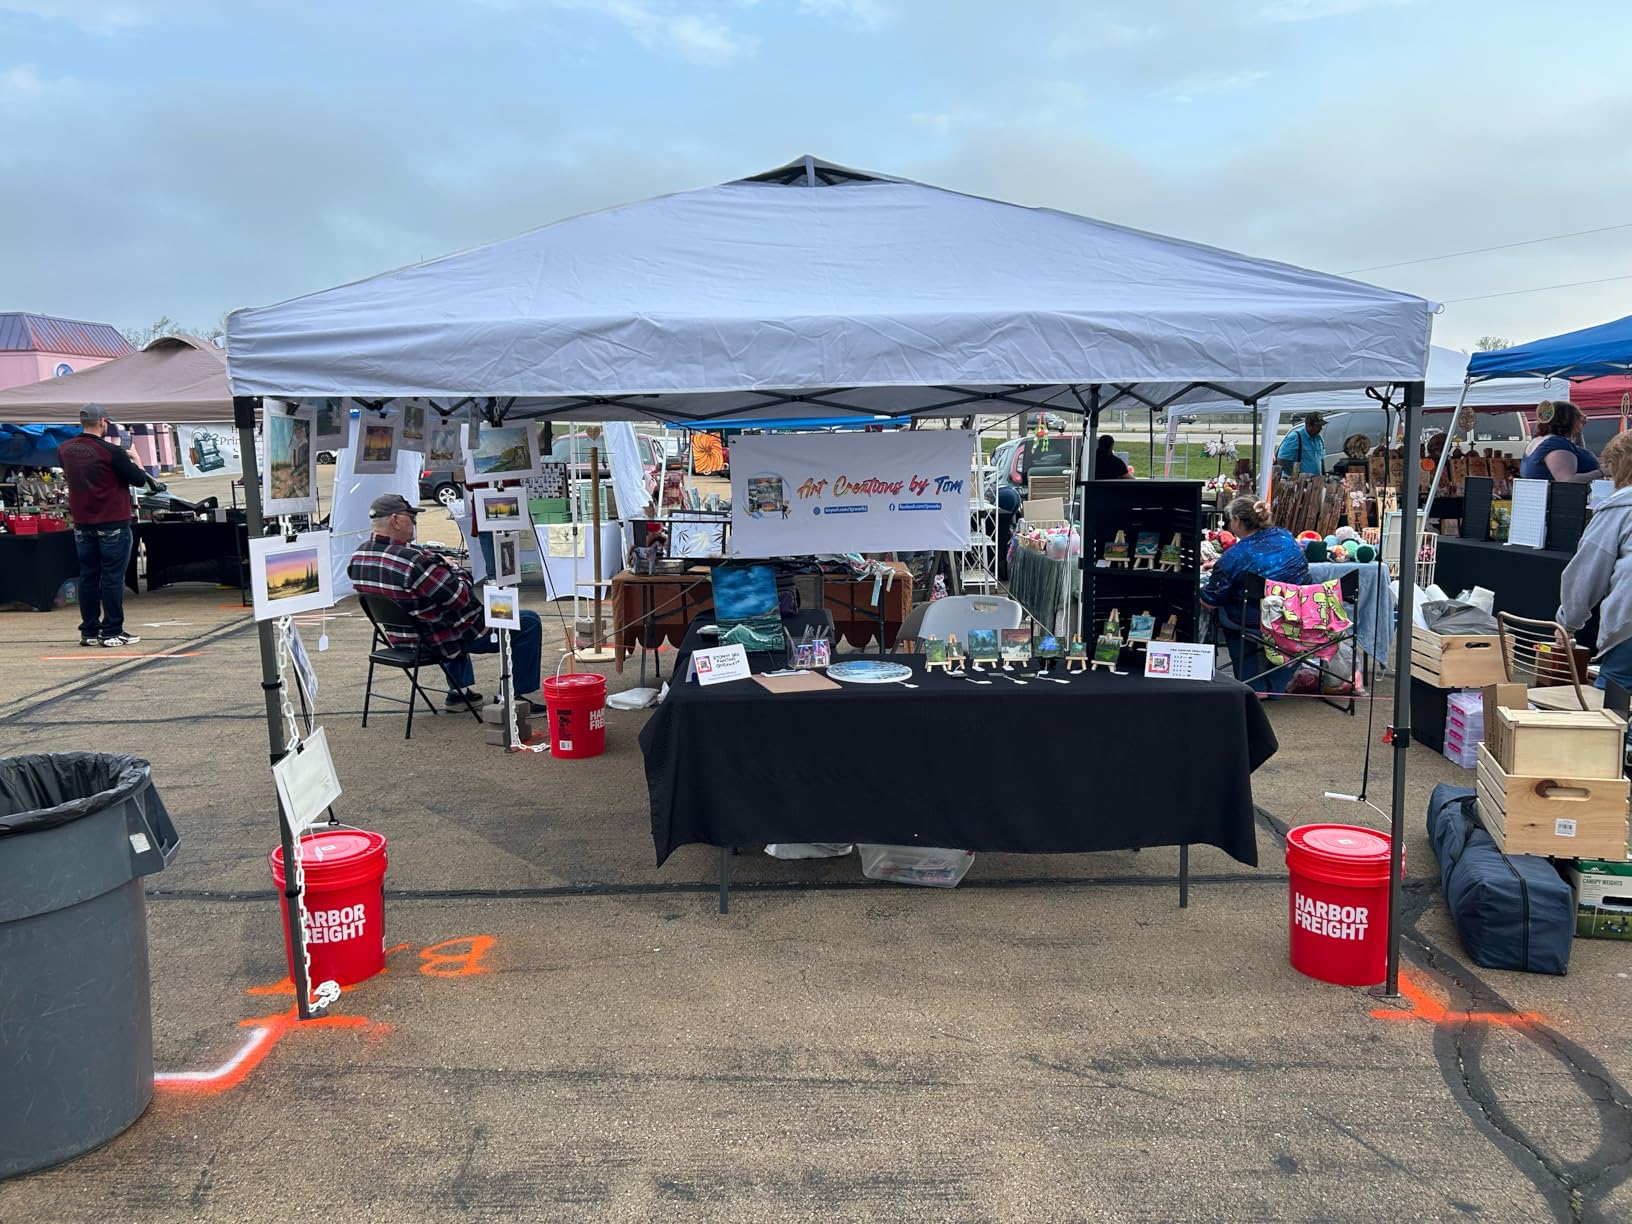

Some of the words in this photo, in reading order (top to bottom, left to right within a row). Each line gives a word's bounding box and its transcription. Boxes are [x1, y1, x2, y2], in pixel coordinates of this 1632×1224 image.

[797, 477, 828, 499] Art
[833, 475, 904, 497] Creations
[909, 474, 930, 496] by
[934, 475, 963, 496] Tom
[301, 903, 366, 928] ARBOR
[1295, 891, 1369, 924] HARBOR
[302, 918, 367, 944] REIGHT
[1295, 908, 1369, 941] FREIGHT
